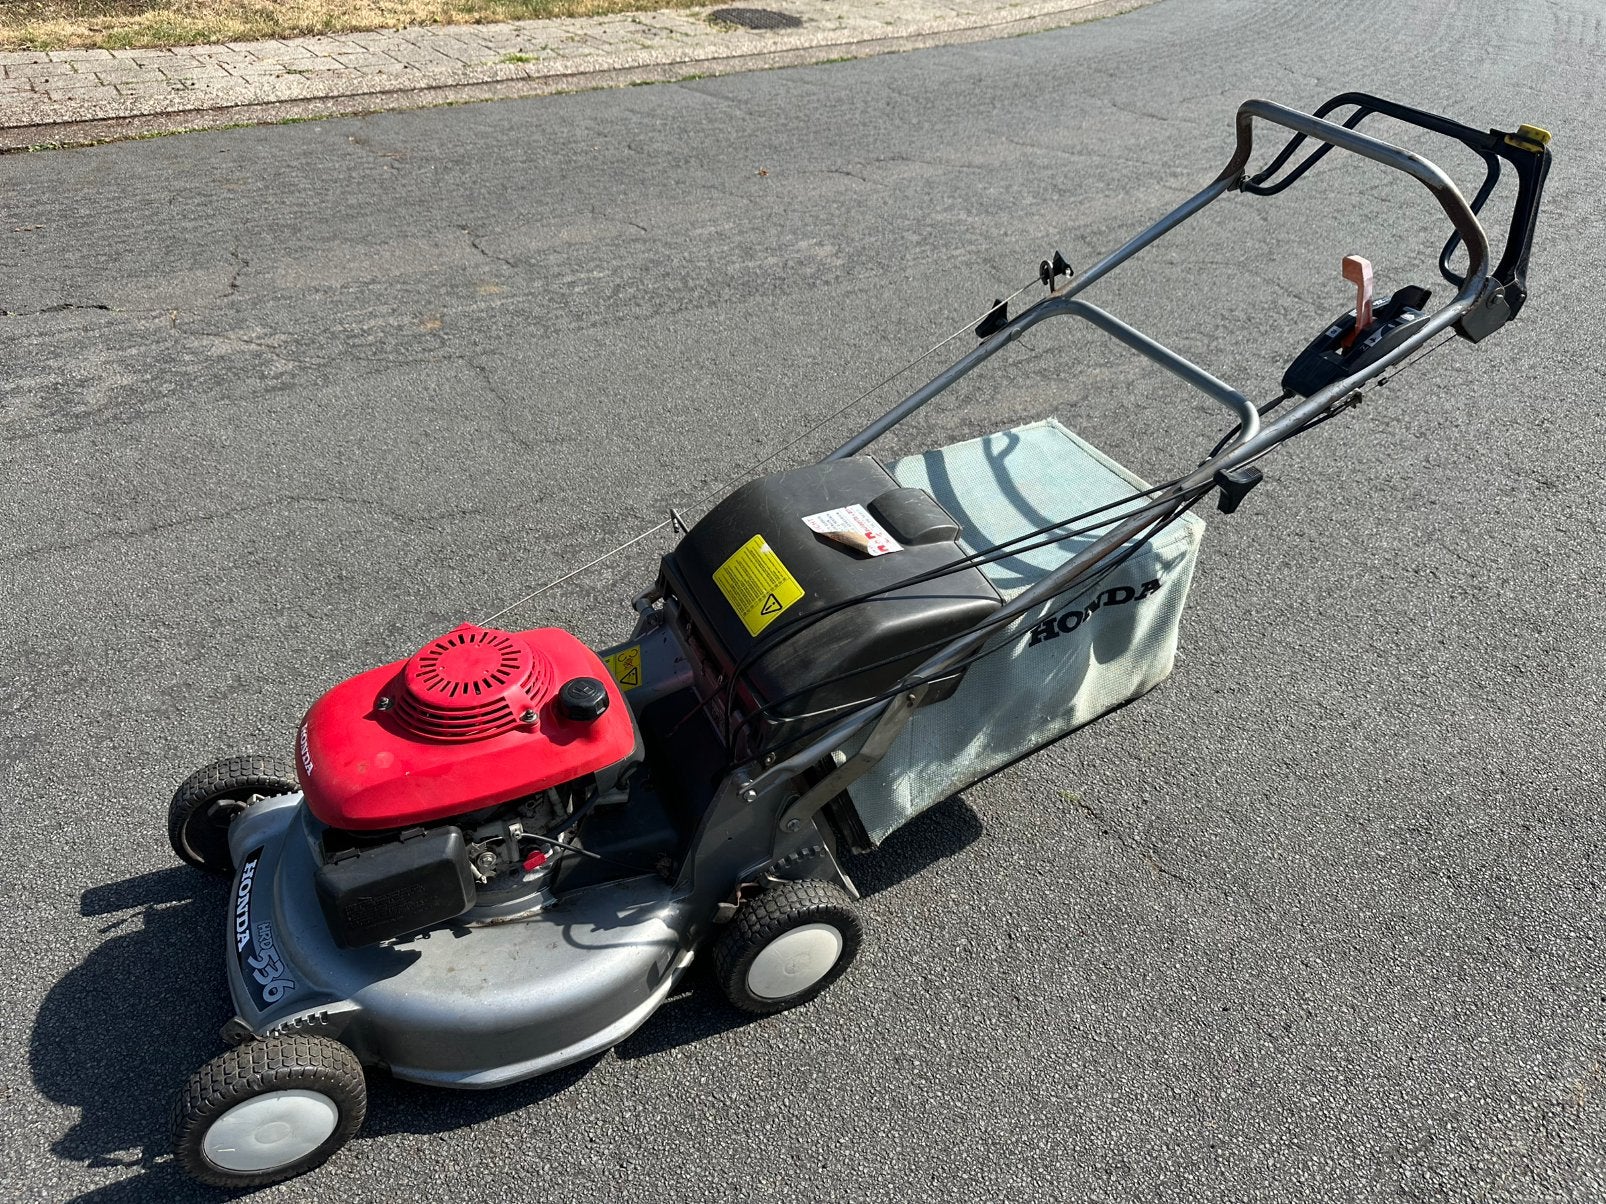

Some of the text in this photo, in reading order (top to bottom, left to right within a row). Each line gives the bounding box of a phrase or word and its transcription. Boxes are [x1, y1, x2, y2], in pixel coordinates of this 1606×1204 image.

[1029, 578, 1162, 648] HONDA
[300, 722, 314, 776] HONDA
[236, 859, 258, 952] HONDA
[247, 921, 296, 1003] HRD536
